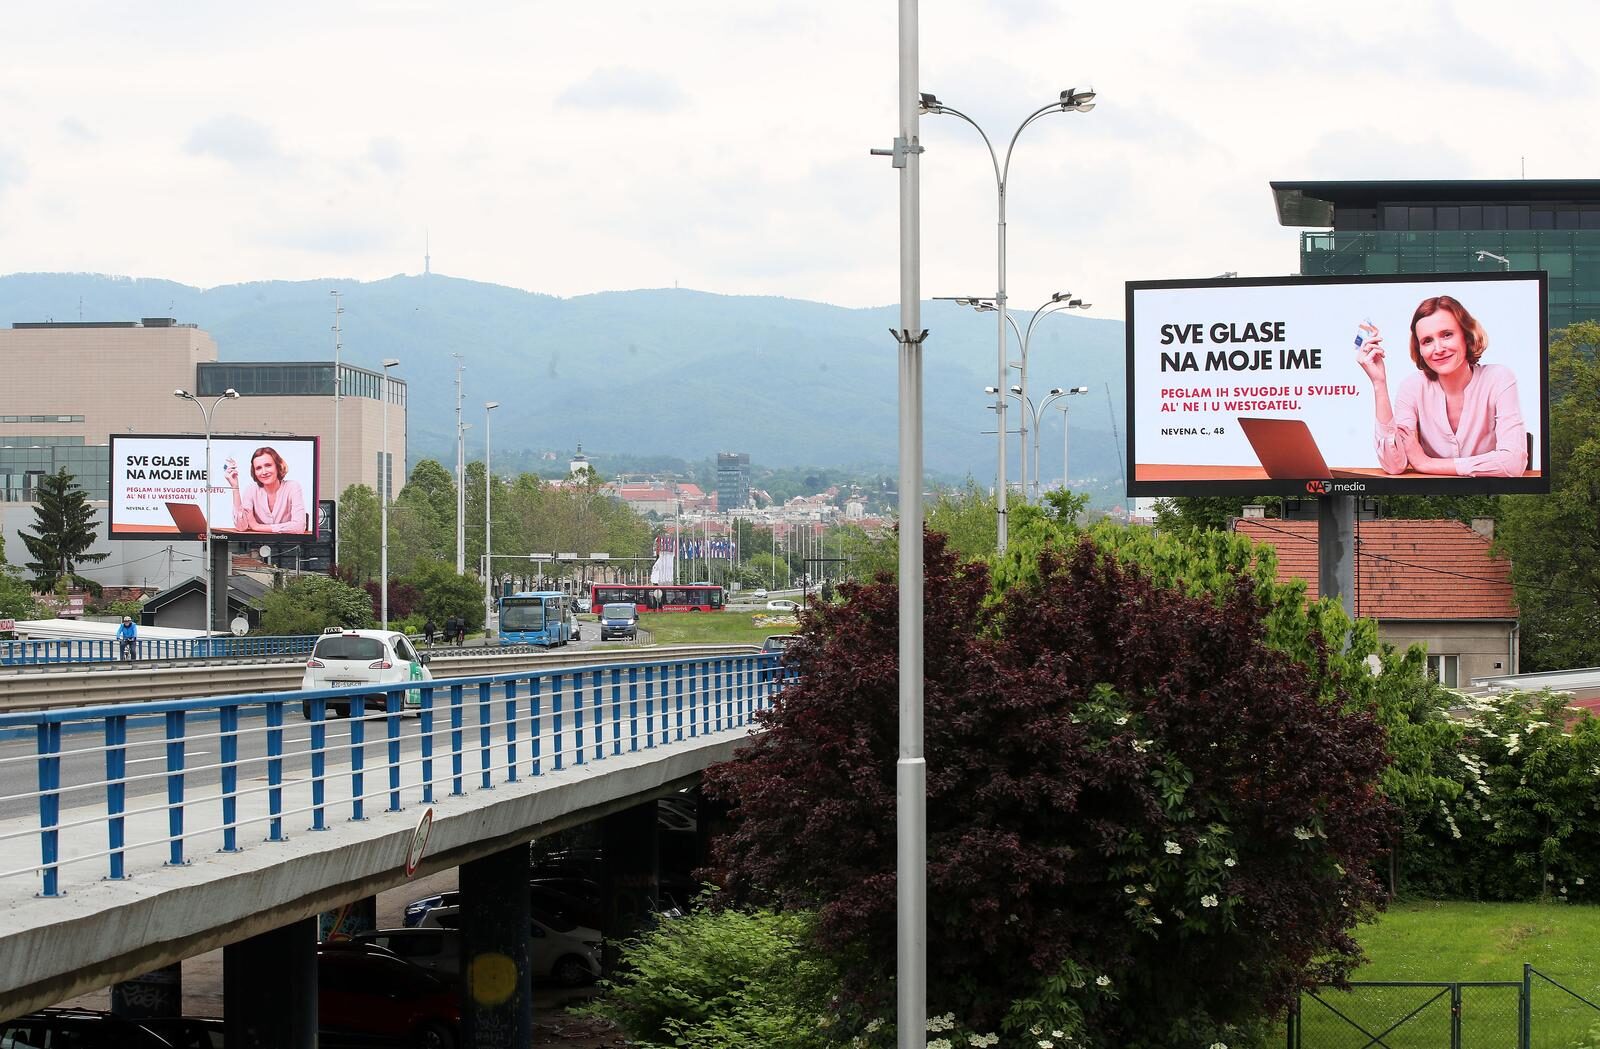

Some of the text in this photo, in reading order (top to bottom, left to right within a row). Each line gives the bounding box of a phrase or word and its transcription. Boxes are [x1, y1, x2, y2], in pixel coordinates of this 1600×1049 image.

[1160, 322, 1286, 346] SVE GLASE
[1160, 348, 1322, 373] NA MOJE IME
[1160, 384, 1360, 399] PEGLAM IH SVUGDJE U SVIJETU,
[1160, 401, 1180, 412] AL'
[1182, 401, 1200, 412] NE
[1210, 401, 1221, 411] U
[1224, 399, 1302, 411] WESTGATEU.
[1160, 426, 1225, 437] NEVENA C., 48
[126, 455, 190, 467] SVE GLASE
[126, 469, 207, 481] NA MOJE IME
[1306, 481, 1366, 493] NAF media
